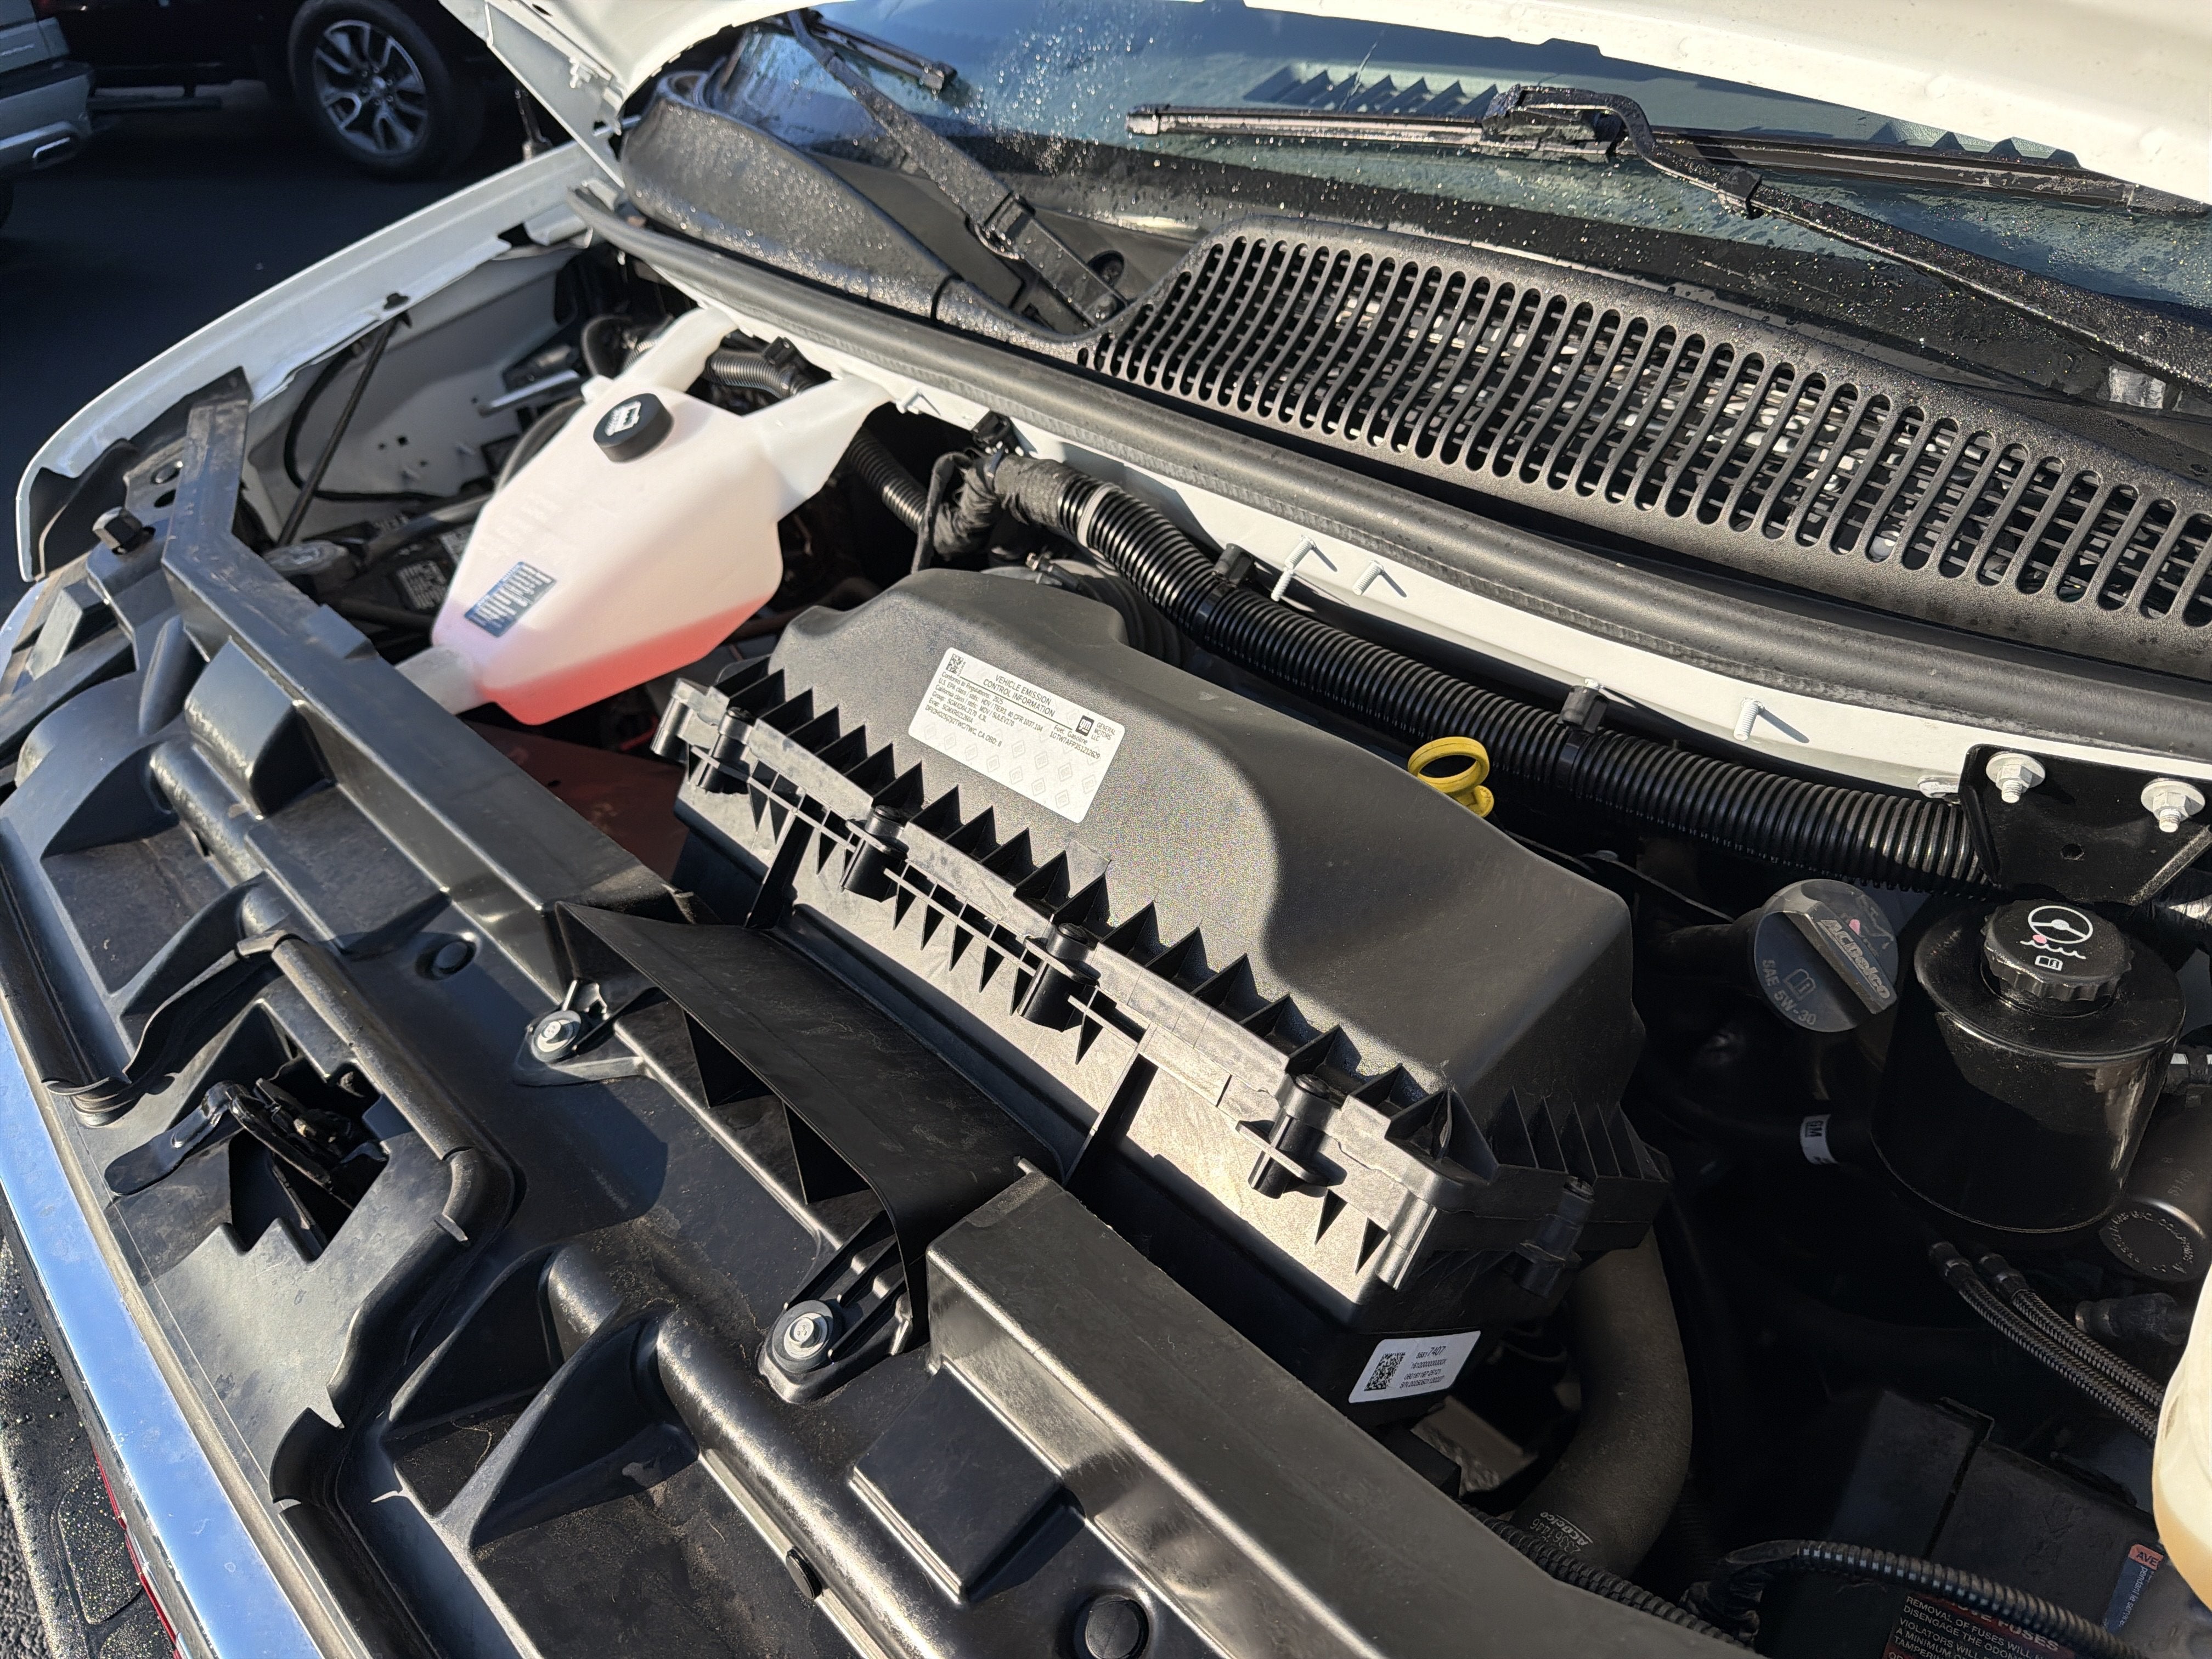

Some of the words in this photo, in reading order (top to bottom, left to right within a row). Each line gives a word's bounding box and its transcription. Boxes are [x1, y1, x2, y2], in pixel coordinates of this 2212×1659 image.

[932, 690, 946, 702] Group:
[935, 684, 954, 697] California
[953, 694, 964, 703] class
[941, 671, 961, 685] Conforms
[966, 682, 991, 698] Regulations:
[983, 679, 1011, 697] CONTROL
[1012, 692, 1055, 716] INFORMATION
[995, 674, 1021, 691] VEHICLE
[1020, 686, 1051, 706] EMISSION
[928, 697, 940, 707] Evap:
[946, 681, 956, 690] EPA
[955, 686, 967, 696] class
[980, 698, 992, 707] HDV
[1013, 713, 1024, 723] CFR
[977, 730, 985, 738] CA
[985, 735, 997, 745] OBD:
[1053, 724, 1065, 734] Fuel:
[1067, 731, 1088, 745] Gasoline
[1093, 727, 1112, 740] MOTORS
[1096, 722, 1115, 735] GENERAL
[1820, 919, 1891, 999] ACDelco
[1762, 960, 1780, 987] SAE
[1774, 989, 1817, 1025] 5W-30
[1540, 1512, 1589, 1546] ACDelco
[1900, 1617, 1954, 1648] VIOLATORS
[1956, 1642, 1979, 1659] WILL
[1903, 1605, 1960, 1637] DISENGAGE
[1962, 1631, 1983, 1647] THE
[1906, 1595, 1953, 1623] REMOVAL
[1955, 1619, 1970, 1629] OF
[1971, 1626, 2004, 1646] FUSES
[2007, 1641, 2031, 1659] WILL
[1998, 1620, 2059, 1652] FUSES
[1895, 1627, 1903, 1636] A
[1905, 1630, 1953, 1658] MINIMUM
